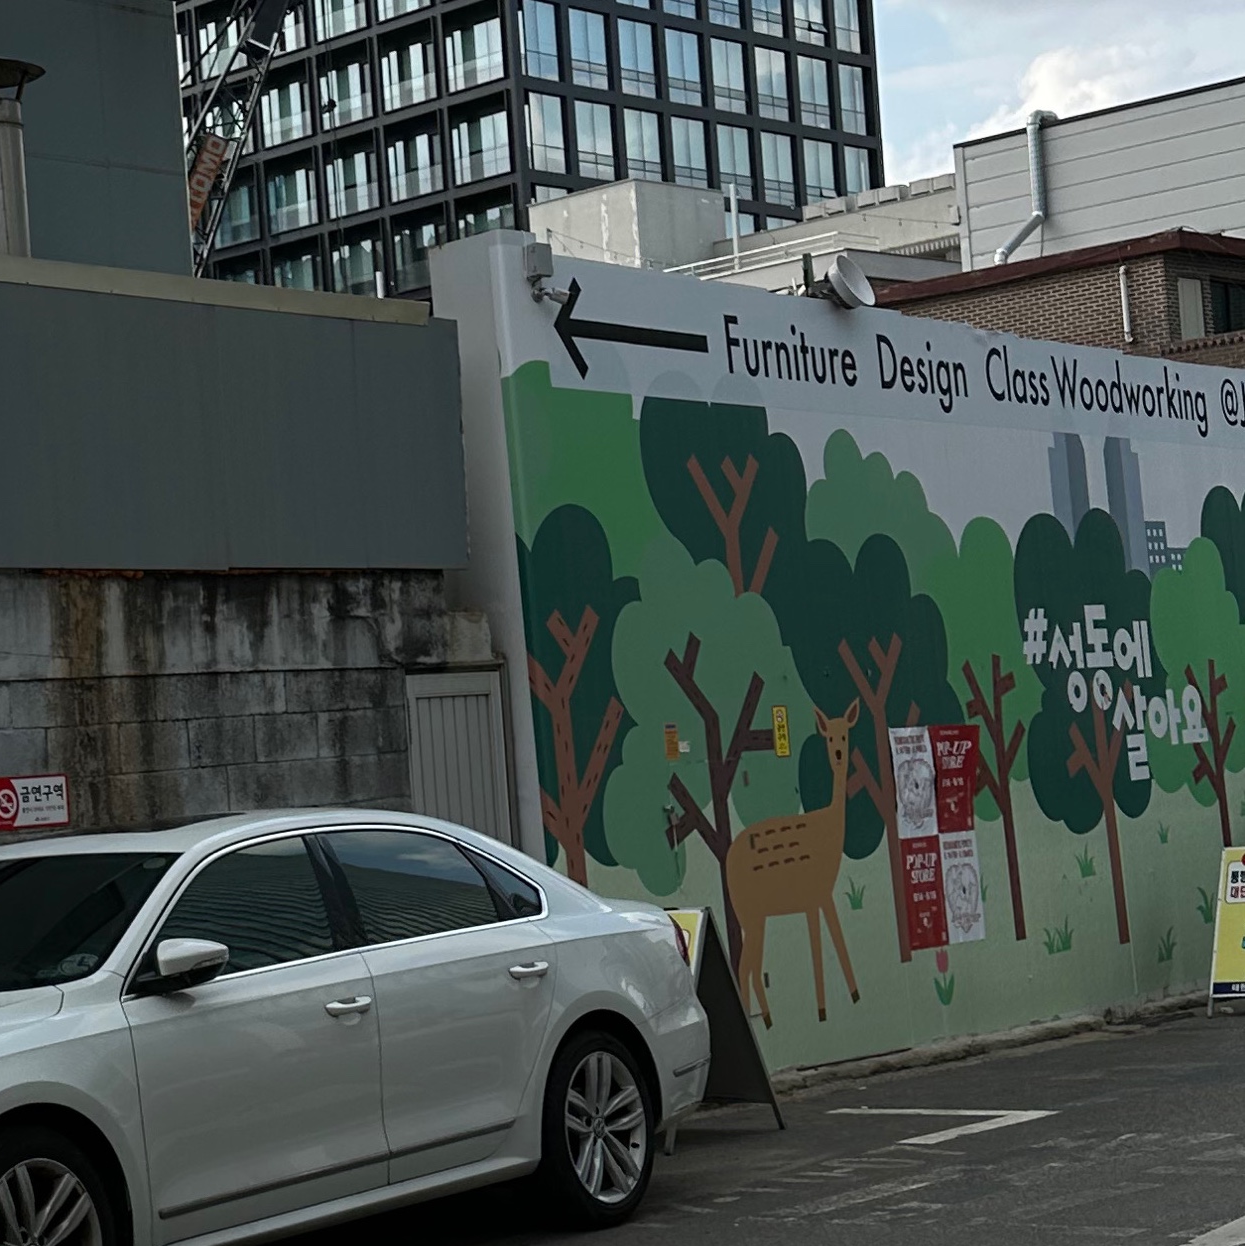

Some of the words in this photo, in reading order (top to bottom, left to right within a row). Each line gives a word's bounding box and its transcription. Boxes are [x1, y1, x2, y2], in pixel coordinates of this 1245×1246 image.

[723, 314, 858, 387] Furniture
[876, 333, 969, 414] Design
[986, 345, 1050, 406] Class
[1050, 355, 1209, 438] Woodworking
[20, 783, 64, 803] 금연구역
